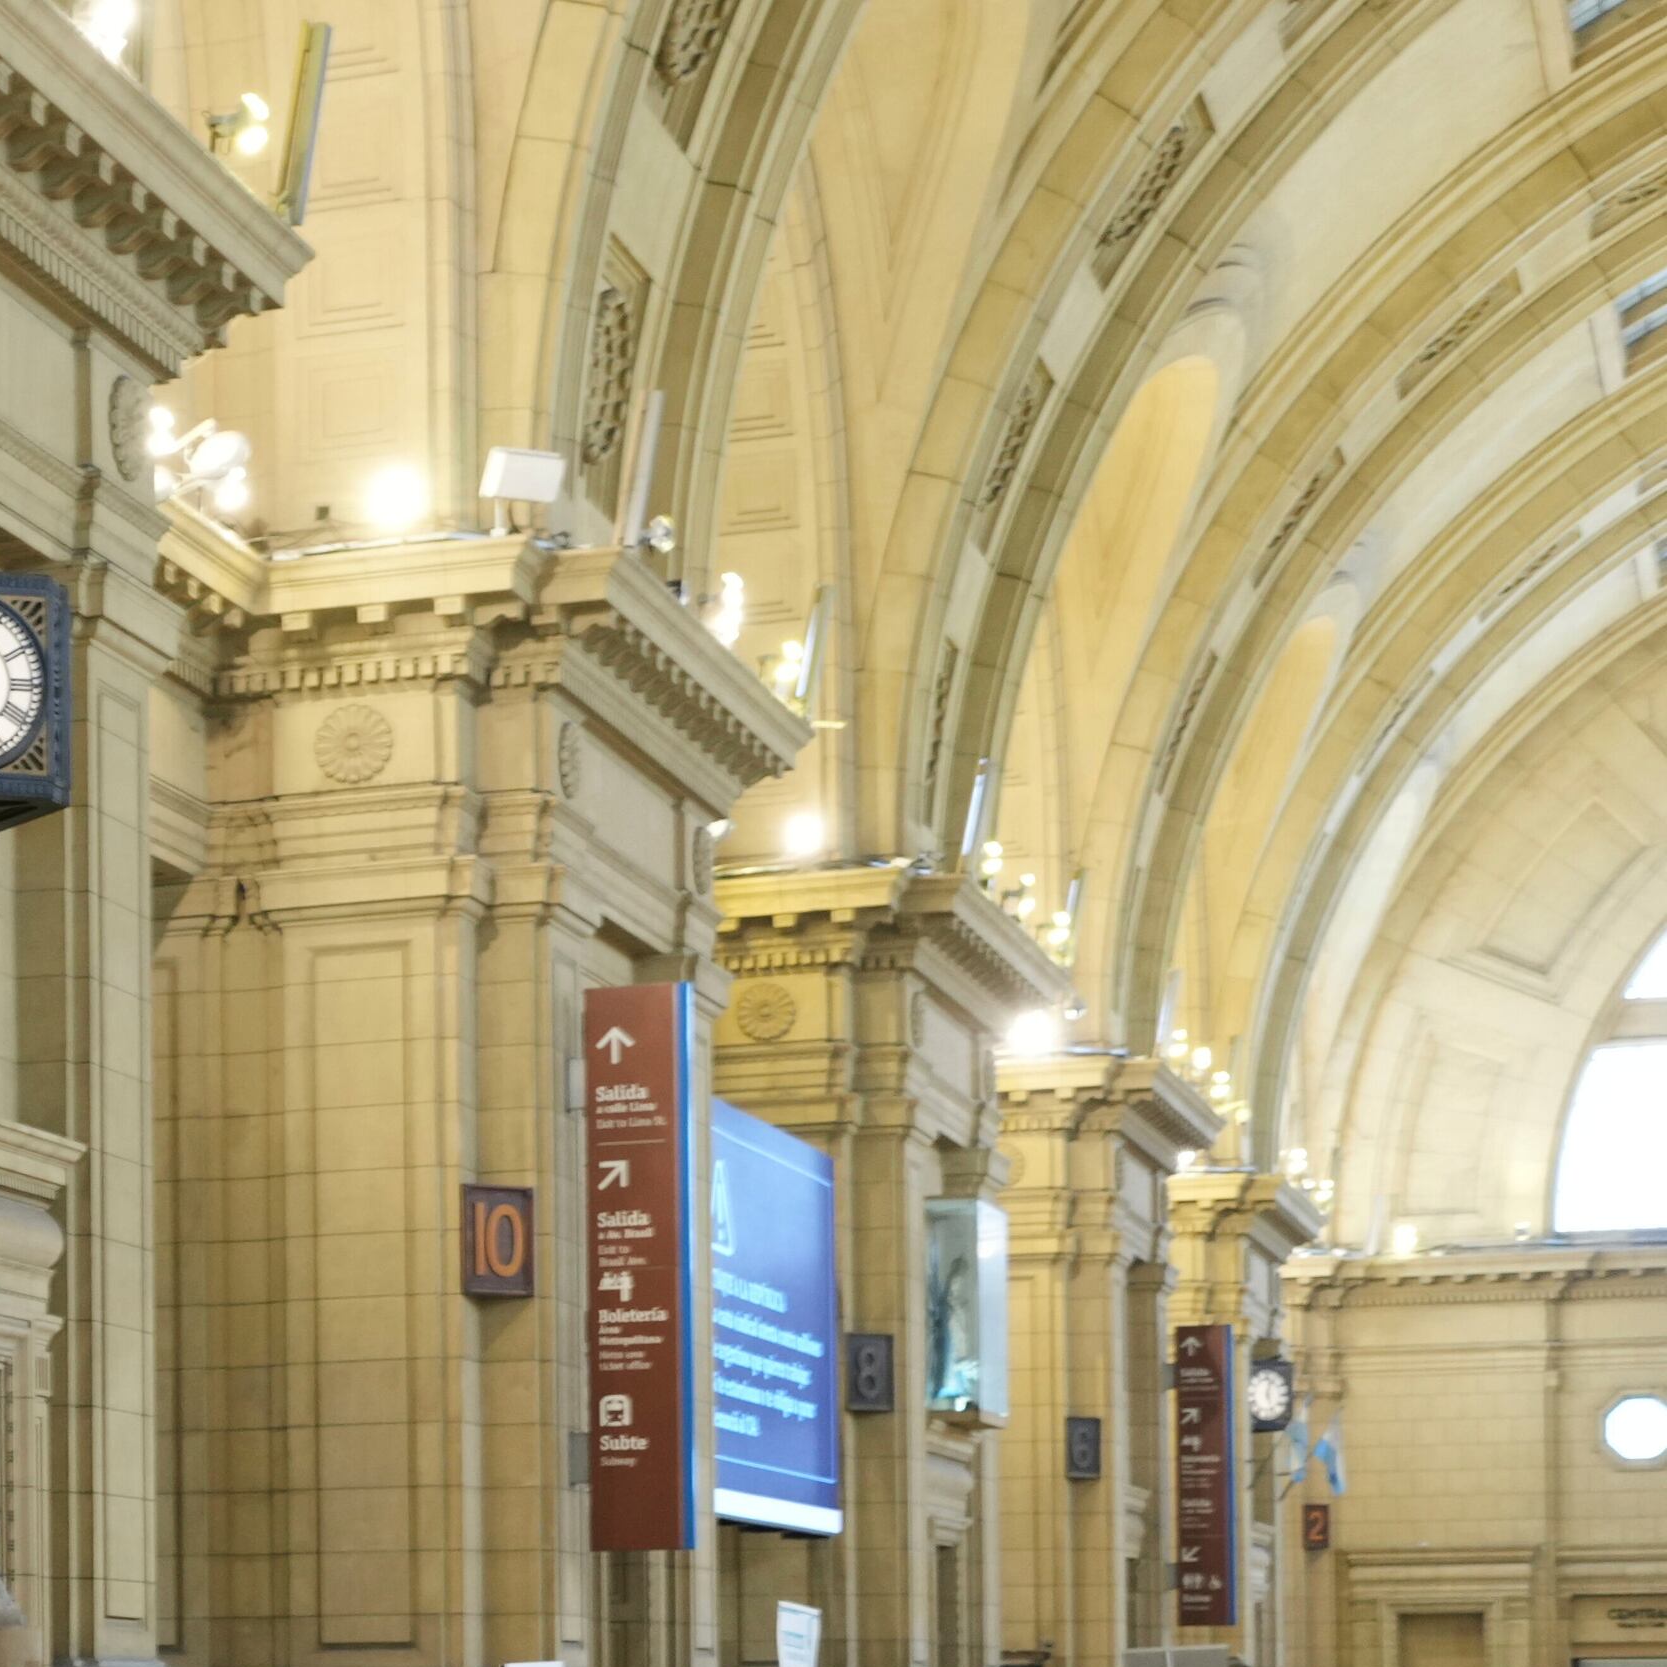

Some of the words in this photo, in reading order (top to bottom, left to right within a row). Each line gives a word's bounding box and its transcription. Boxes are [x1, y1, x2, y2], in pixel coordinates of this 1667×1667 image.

[595, 1084, 649, 1102] Salida
[597, 1210, 651, 1228] Salida
[474, 1201, 523, 1277] 10
[624, 1227, 654, 1238] Brasil
[598, 1307, 668, 1323] Boletería
[599, 1335, 664, 1346] Metropolitana
[856, 1344, 881, 1401] 8
[600, 1435, 649, 1451] Subte
[1072, 1426, 1094, 1469] 6
[600, 1456, 637, 1467] Subway
[1306, 1511, 1324, 1541] 2
